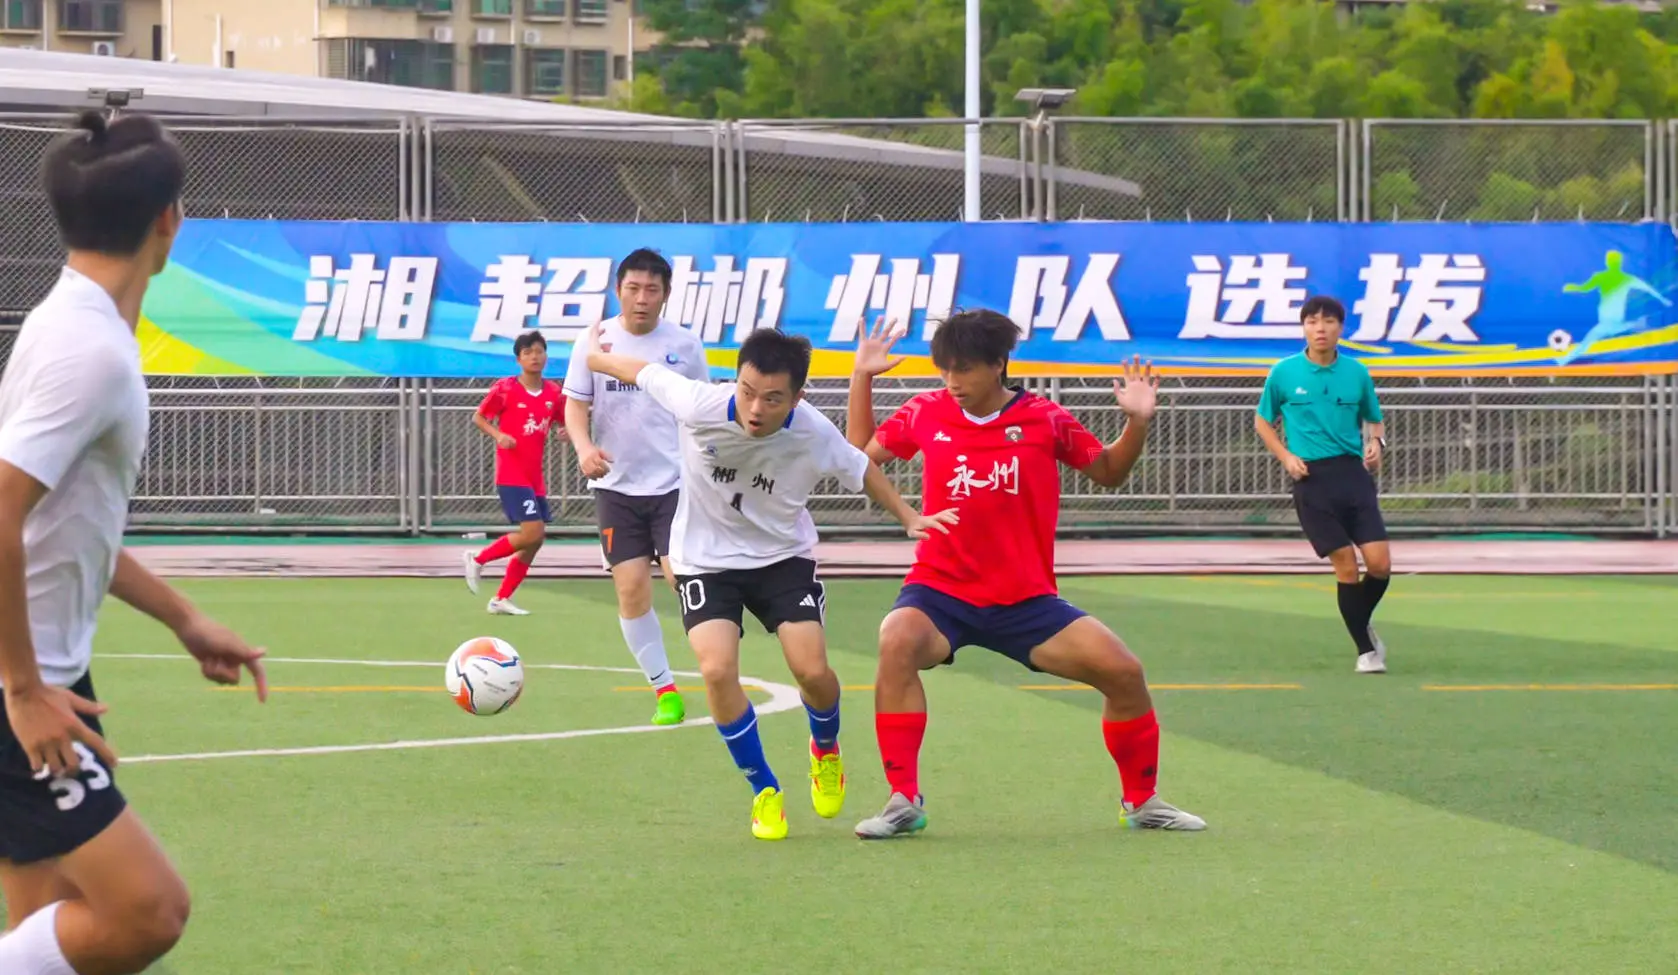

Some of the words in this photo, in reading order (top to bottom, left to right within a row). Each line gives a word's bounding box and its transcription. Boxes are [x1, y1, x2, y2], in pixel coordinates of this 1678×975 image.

[292, 253, 1486, 343] 湘超郴州队选拔
[712, 466, 775, 495] 郴州
[946, 455, 1019, 497] 永州
[523, 500, 537, 515] 2
[679, 578, 706, 615] 10
